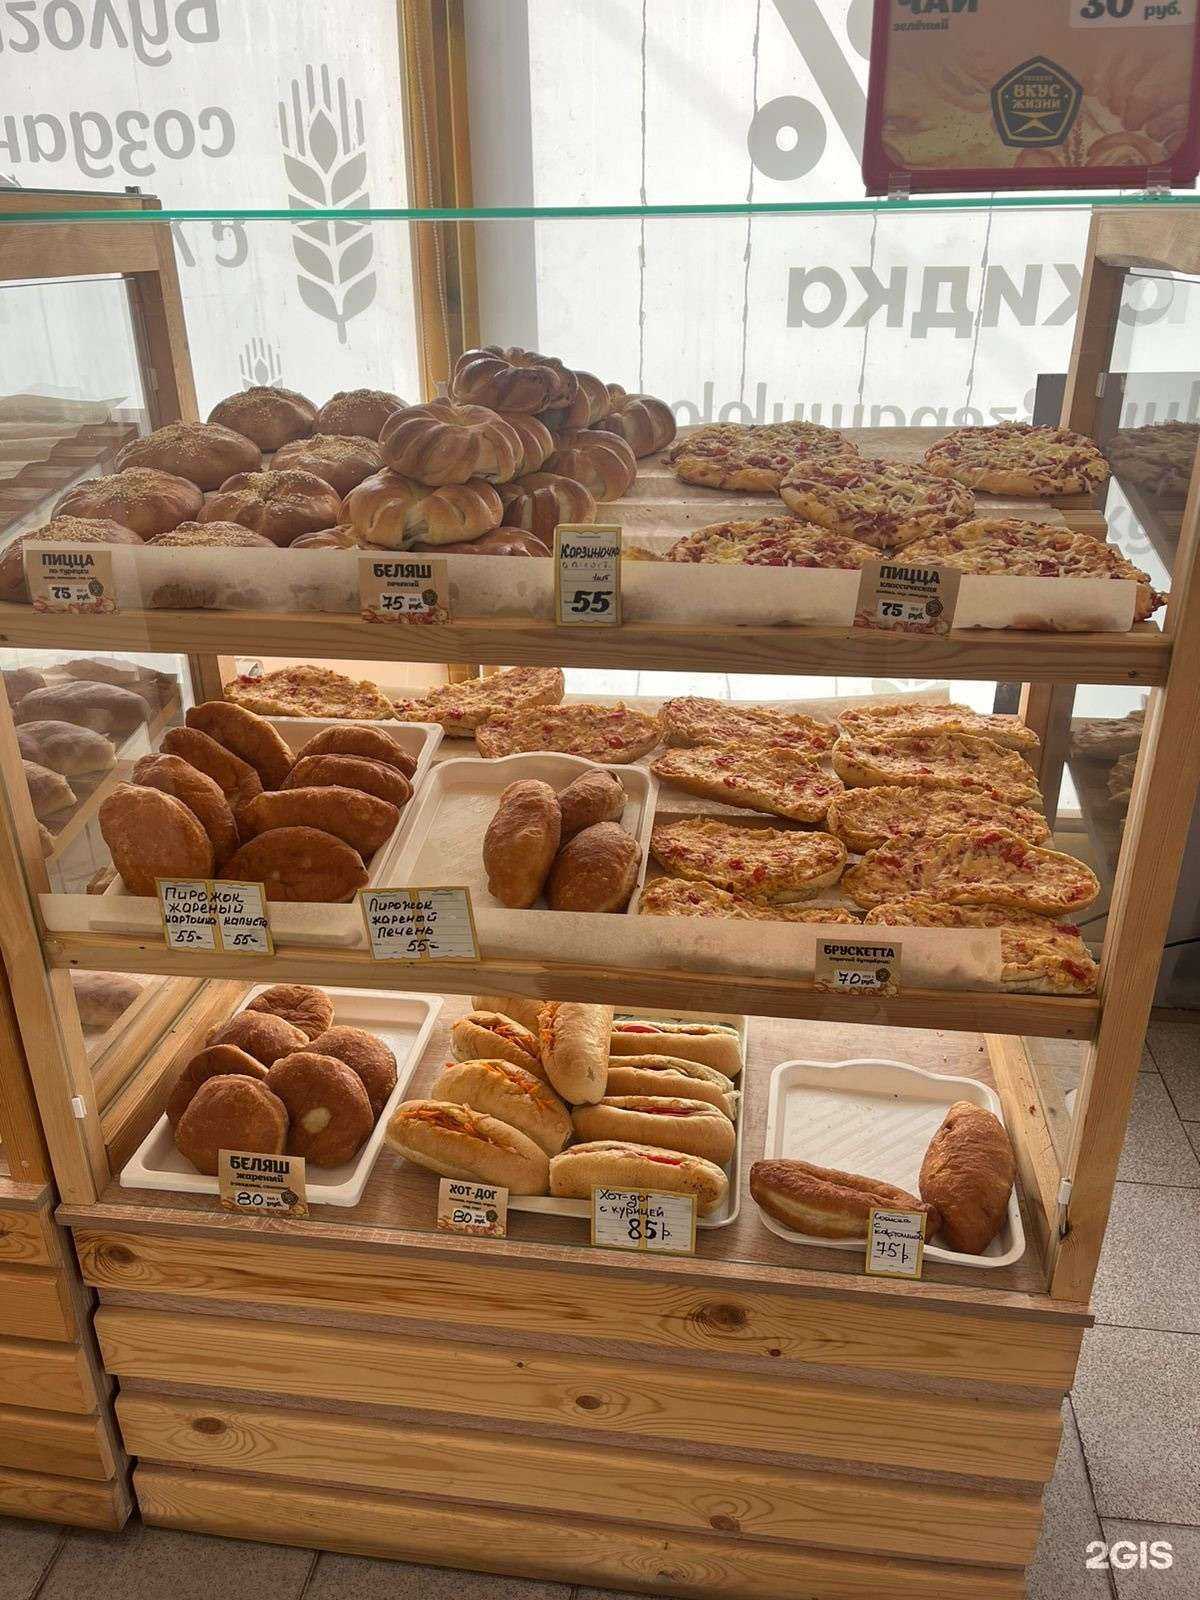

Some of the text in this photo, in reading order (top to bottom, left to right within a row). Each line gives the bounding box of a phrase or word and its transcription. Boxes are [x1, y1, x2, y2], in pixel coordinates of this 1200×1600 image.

[1144, 0, 1181, 20] руб.
[1013, 84, 1060, 98] ВКУС
[1012, 99, 1060, 110] ЖИЗНИ
[41, 553, 95, 568] ПИЦЦА
[373, 563, 432, 579] БЕЛЯШ
[880, 565, 941, 585] ПИЦЦА
[52, 586, 72, 600] 75
[382, 594, 405, 611] 75
[571, 590, 613, 614] 55
[882, 602, 904, 617] 75
[165, 887, 245, 903] Пирожок
[369, 898, 433, 912] Пирожок
[824, 944, 895, 958] БРУСКЕТТА
[839, 971, 861, 985] 70
[230, 1155, 290, 1174] БЕЛЯШ
[236, 1172, 284, 1183] жареный
[237, 1191, 264, 1206] 80
[449, 1184, 497, 1200] ХОТ-ДОГ
[453, 1209, 472, 1223] 80
[612, 1206, 664, 1219] курицей
